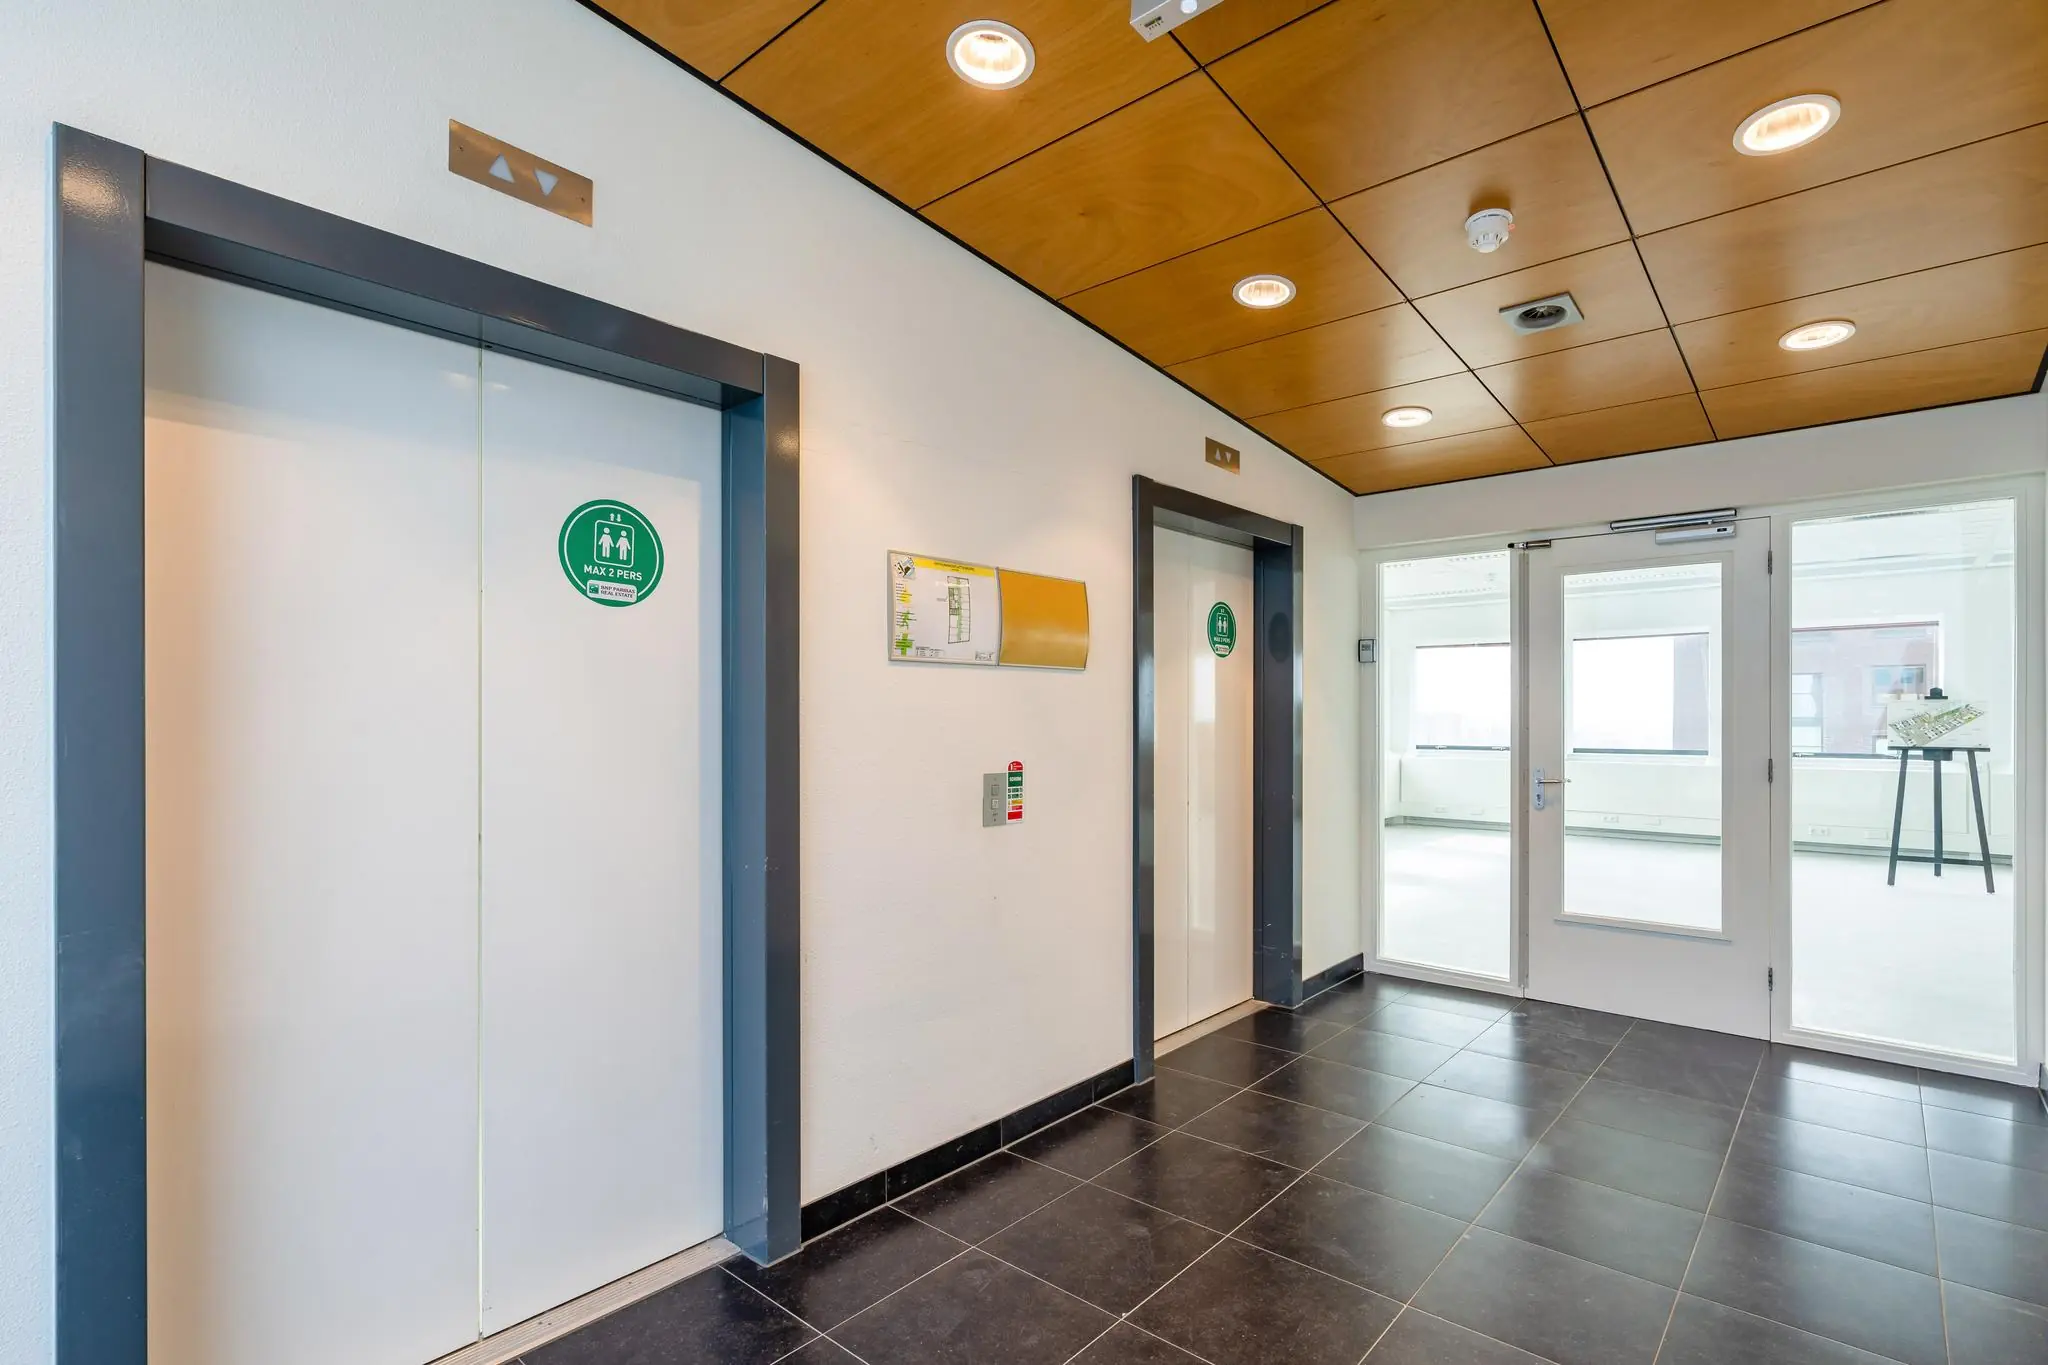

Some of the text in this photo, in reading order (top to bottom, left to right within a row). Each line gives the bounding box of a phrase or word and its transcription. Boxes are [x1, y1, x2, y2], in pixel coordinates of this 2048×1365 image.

[583, 564, 643, 581] MAX 2 PERS
